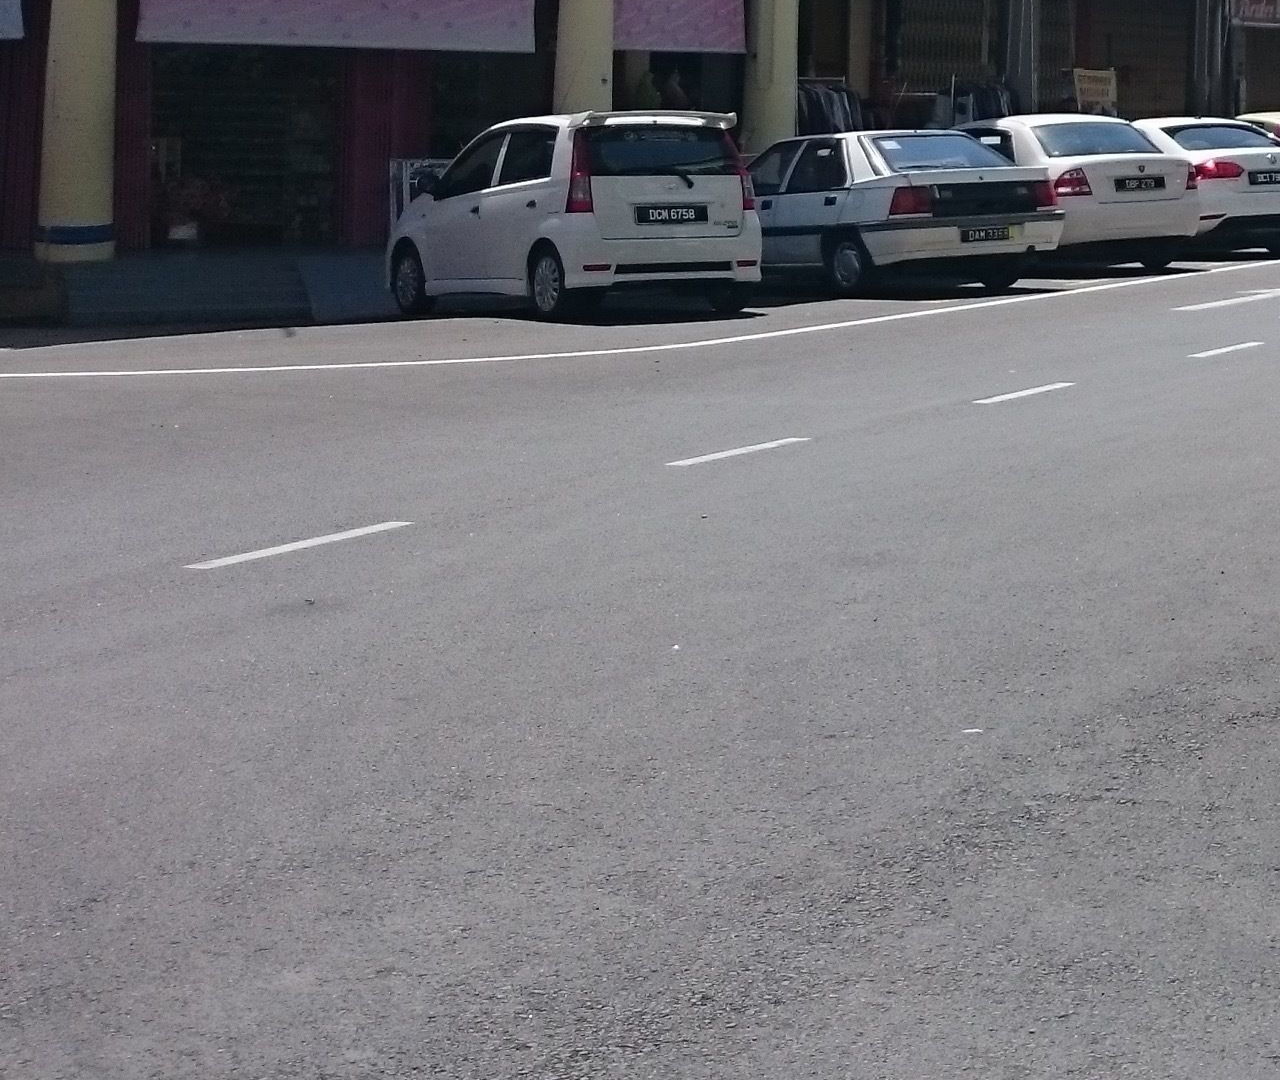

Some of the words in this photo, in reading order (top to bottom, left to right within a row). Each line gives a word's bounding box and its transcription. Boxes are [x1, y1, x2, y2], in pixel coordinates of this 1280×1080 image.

[650, 209, 669, 220] DCM
[670, 208, 695, 220] 6758
[968, 230, 986, 241] DAM
